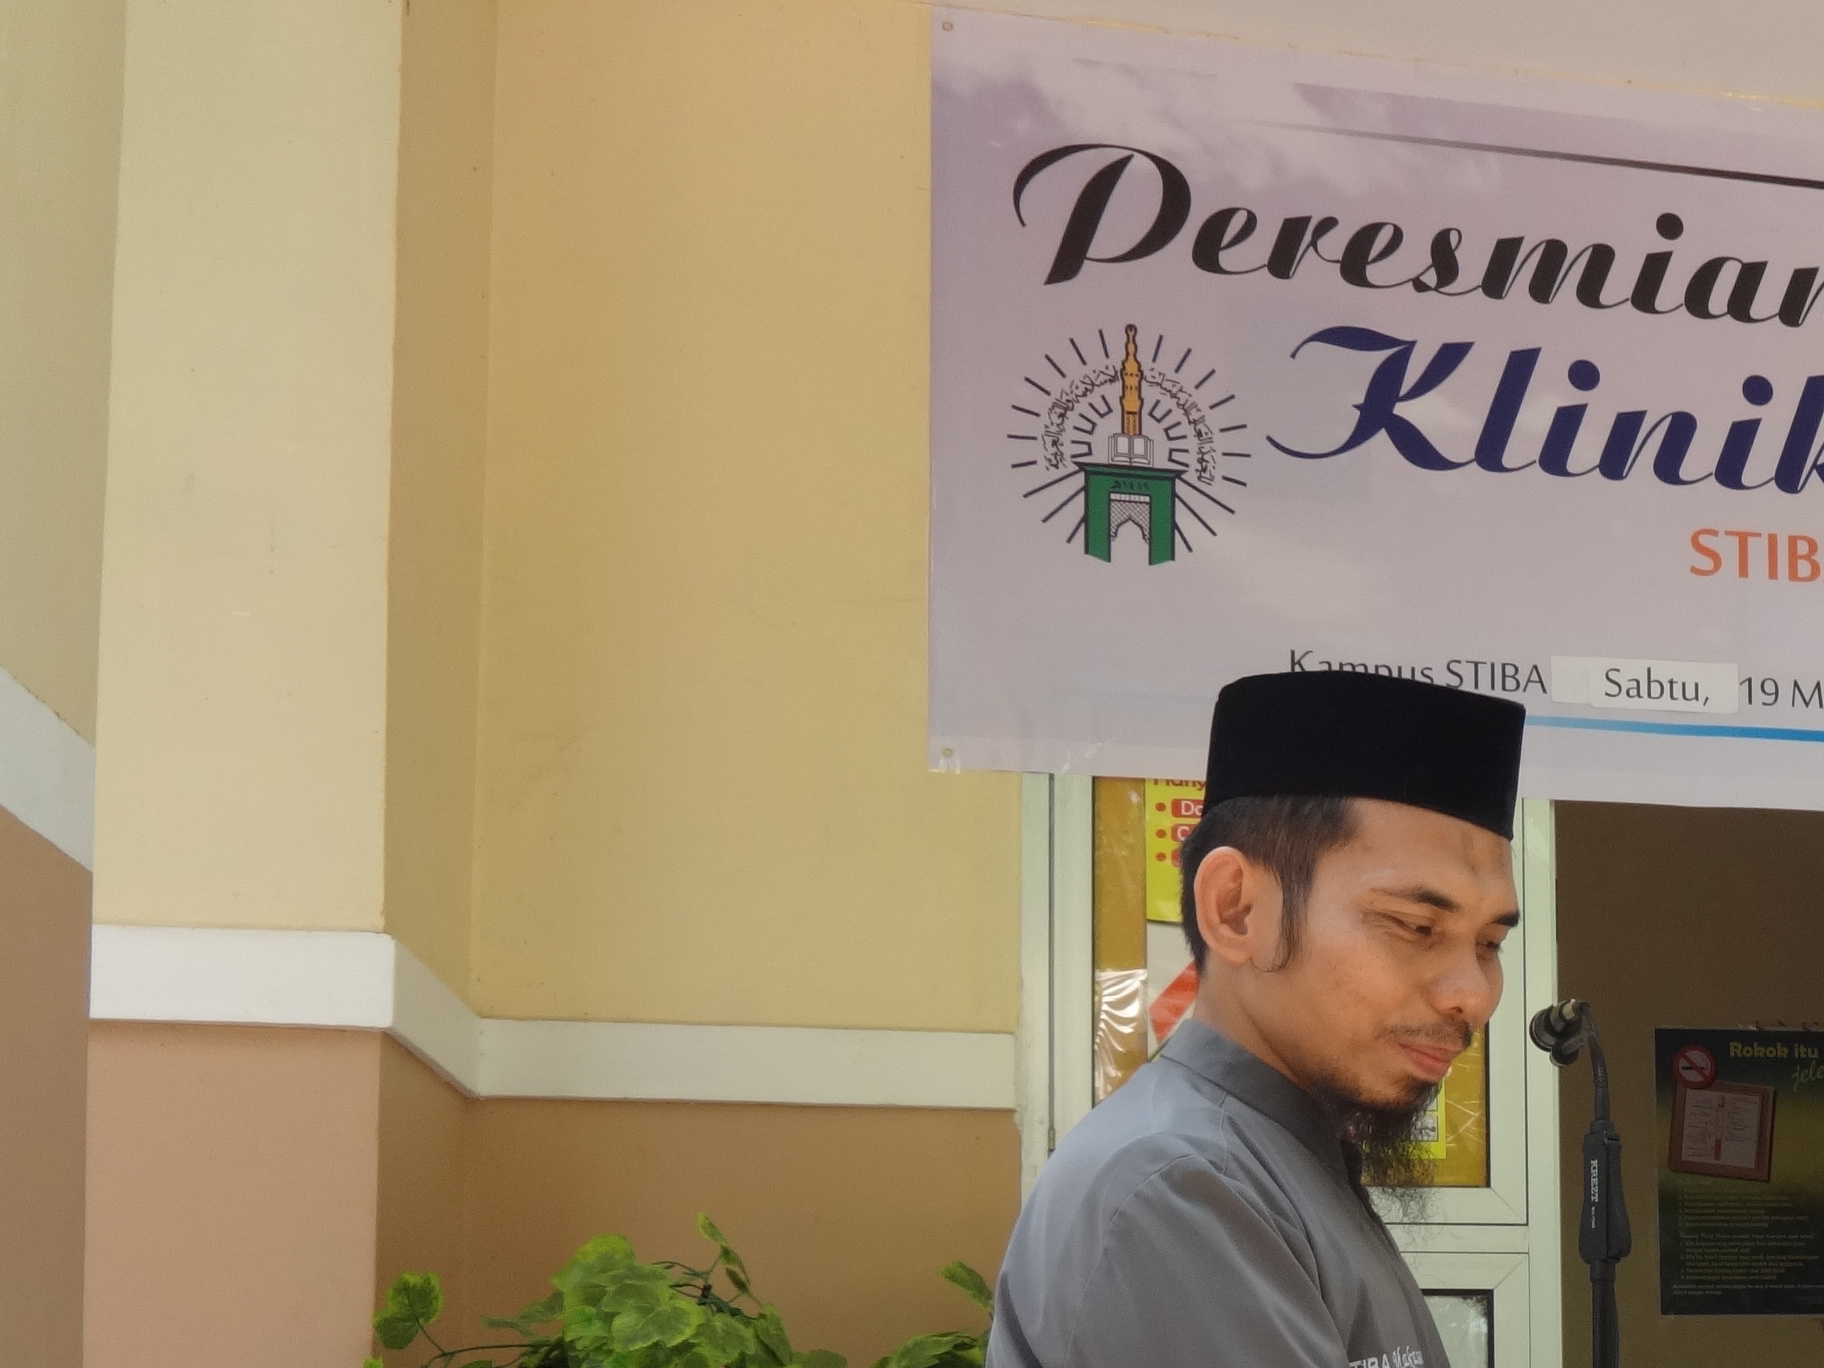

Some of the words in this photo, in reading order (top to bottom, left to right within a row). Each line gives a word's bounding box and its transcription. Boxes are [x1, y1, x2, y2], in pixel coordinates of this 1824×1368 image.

[1445, 659, 1549, 694] STIBA
[1604, 667, 1711, 707] Sabtu,
[1740, 677, 1781, 707] 19
[1729, 1041, 1789, 1059] Rokok
[1794, 1041, 1819, 1060] itu
